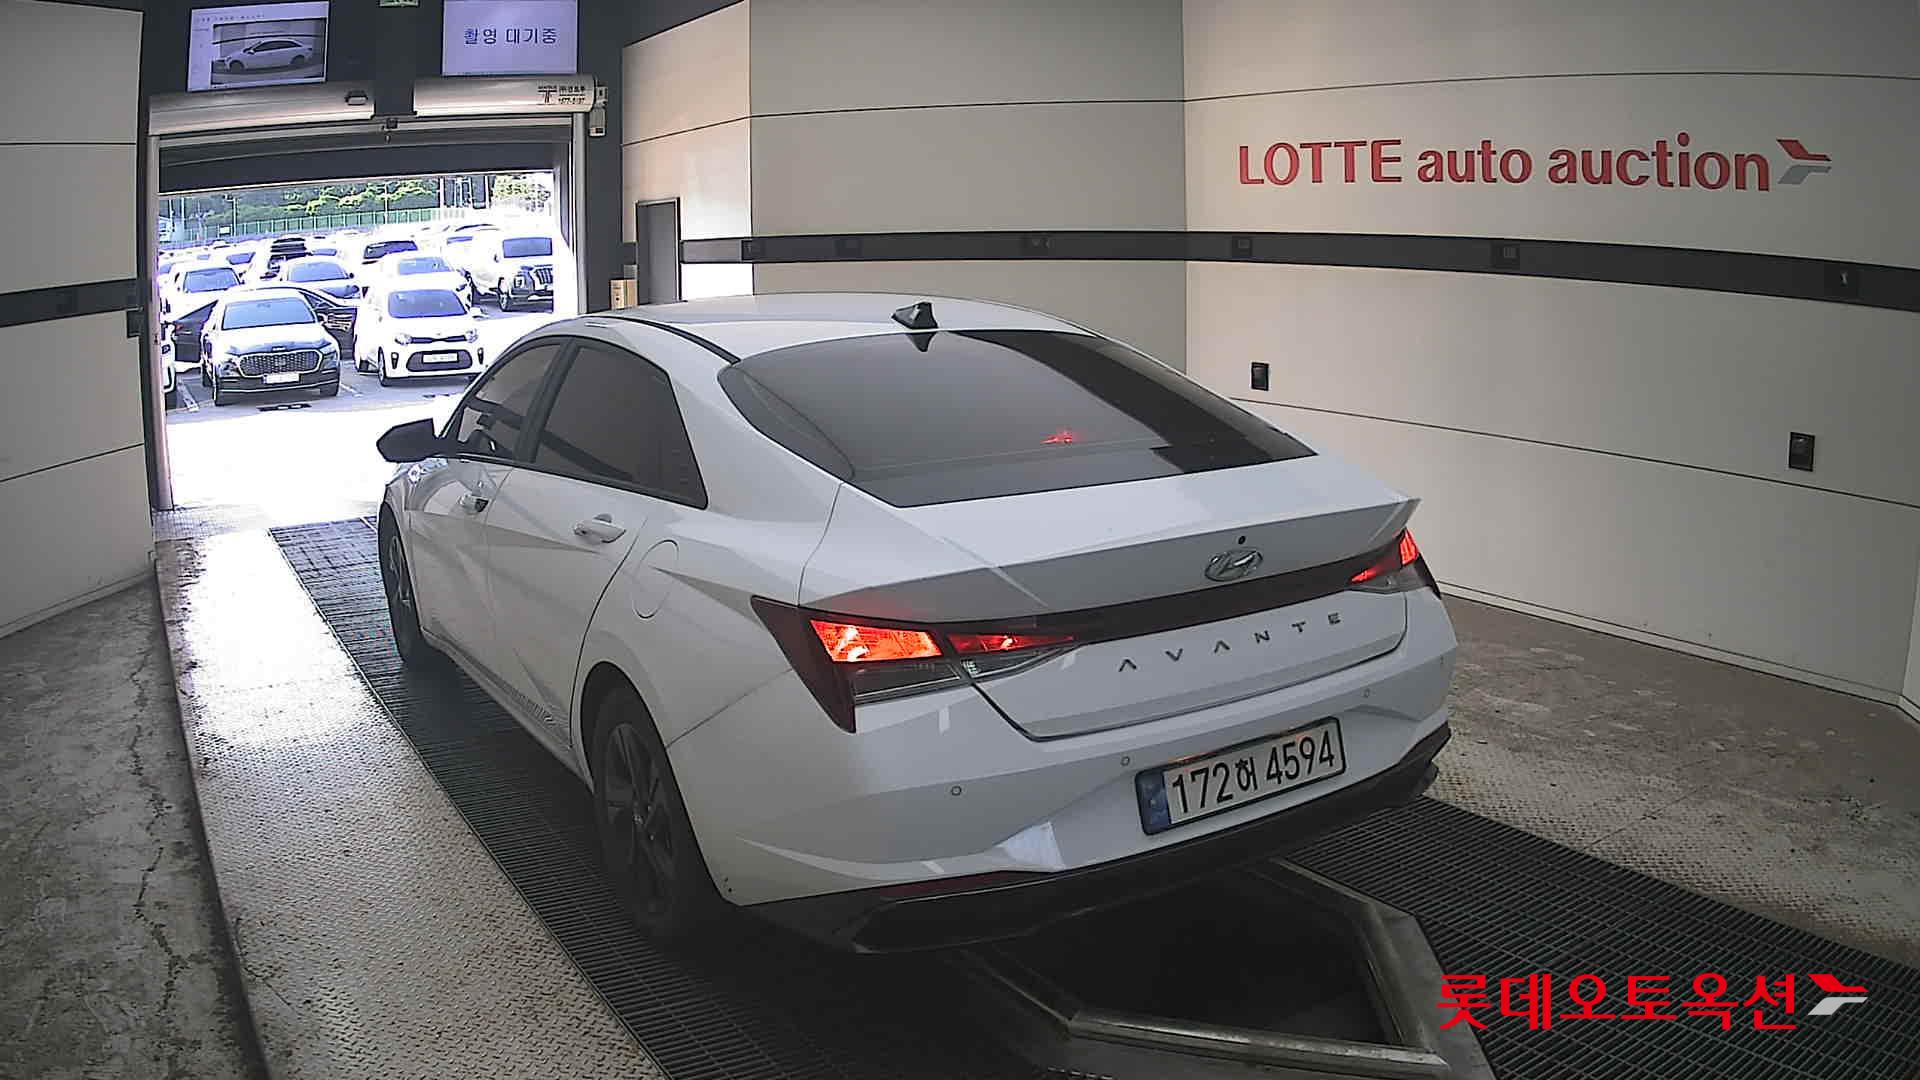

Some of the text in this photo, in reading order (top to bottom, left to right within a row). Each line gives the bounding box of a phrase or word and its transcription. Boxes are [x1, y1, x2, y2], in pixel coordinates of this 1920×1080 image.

[463, 28, 557, 45] 촬영 대기중
[1239, 132, 1770, 191] LOTTE auto auction
[1118, 612, 1342, 673] AVANTE
[1266, 730, 1335, 785] 4594
